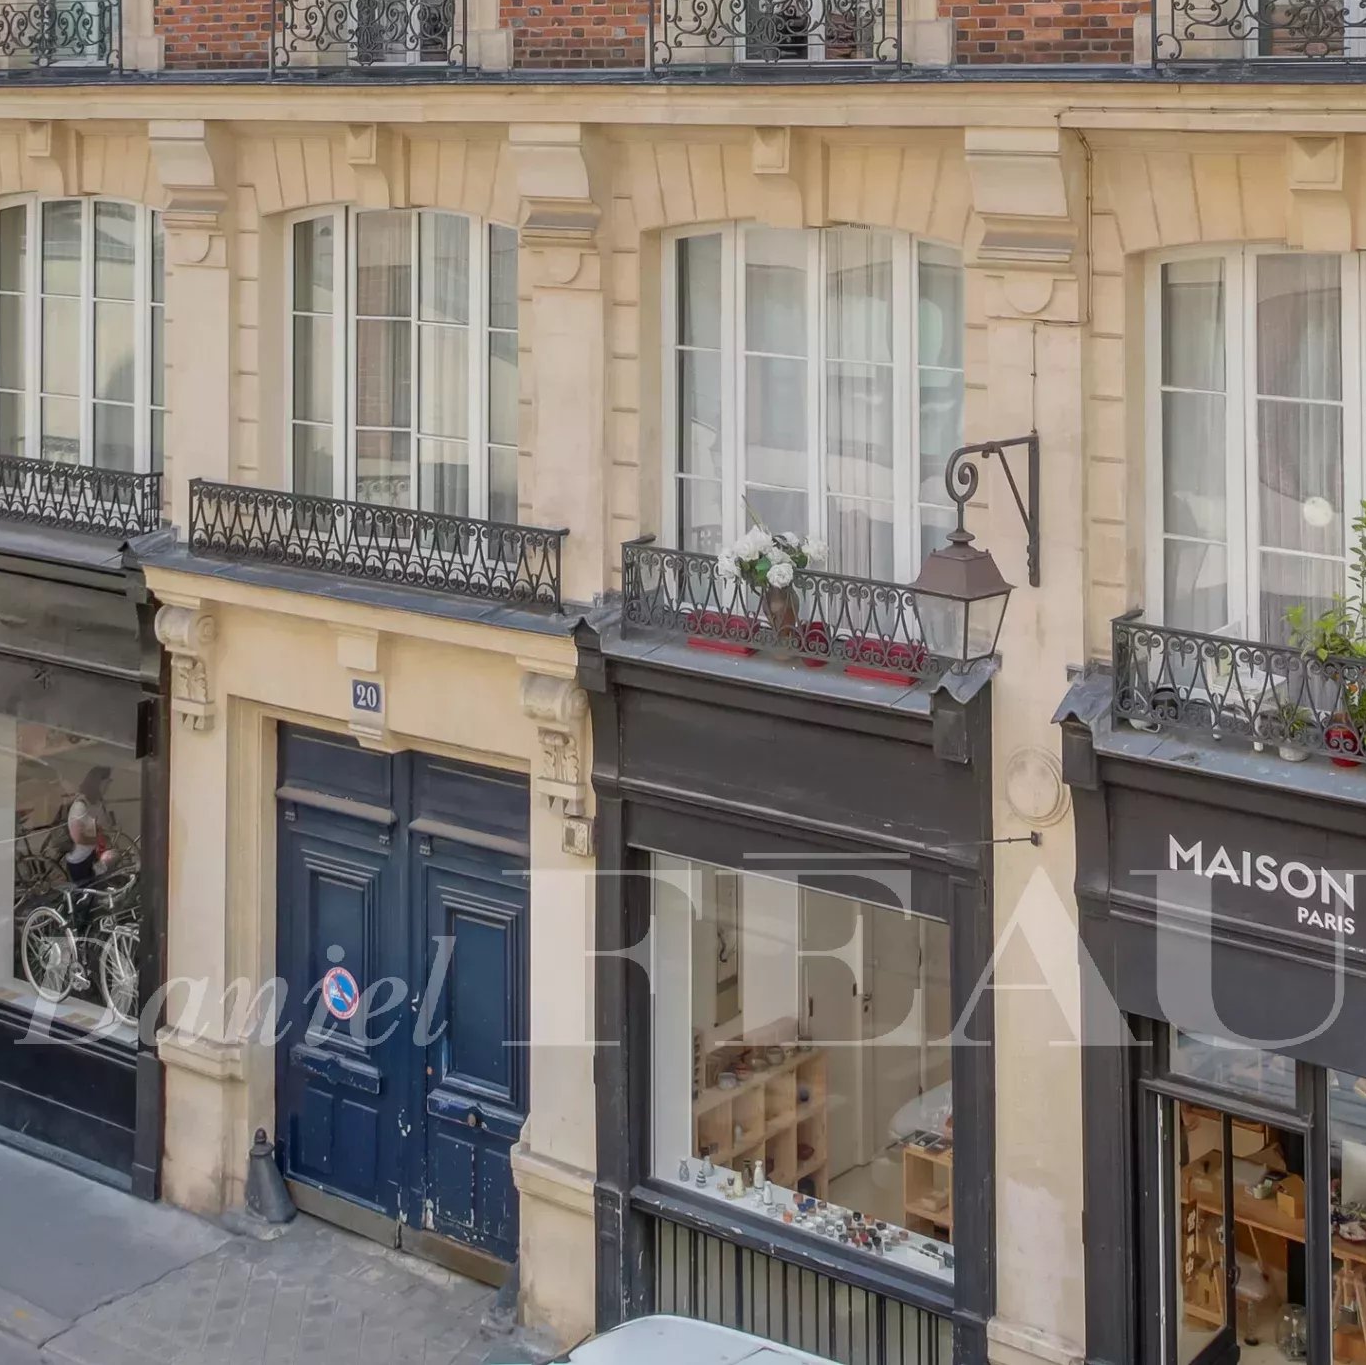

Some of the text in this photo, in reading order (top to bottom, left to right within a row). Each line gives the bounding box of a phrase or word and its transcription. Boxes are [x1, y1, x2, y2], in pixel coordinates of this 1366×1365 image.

[356, 684, 377, 708] 20
[1168, 833, 1355, 911] MAISON
[1297, 906, 1356, 935] PARIS
